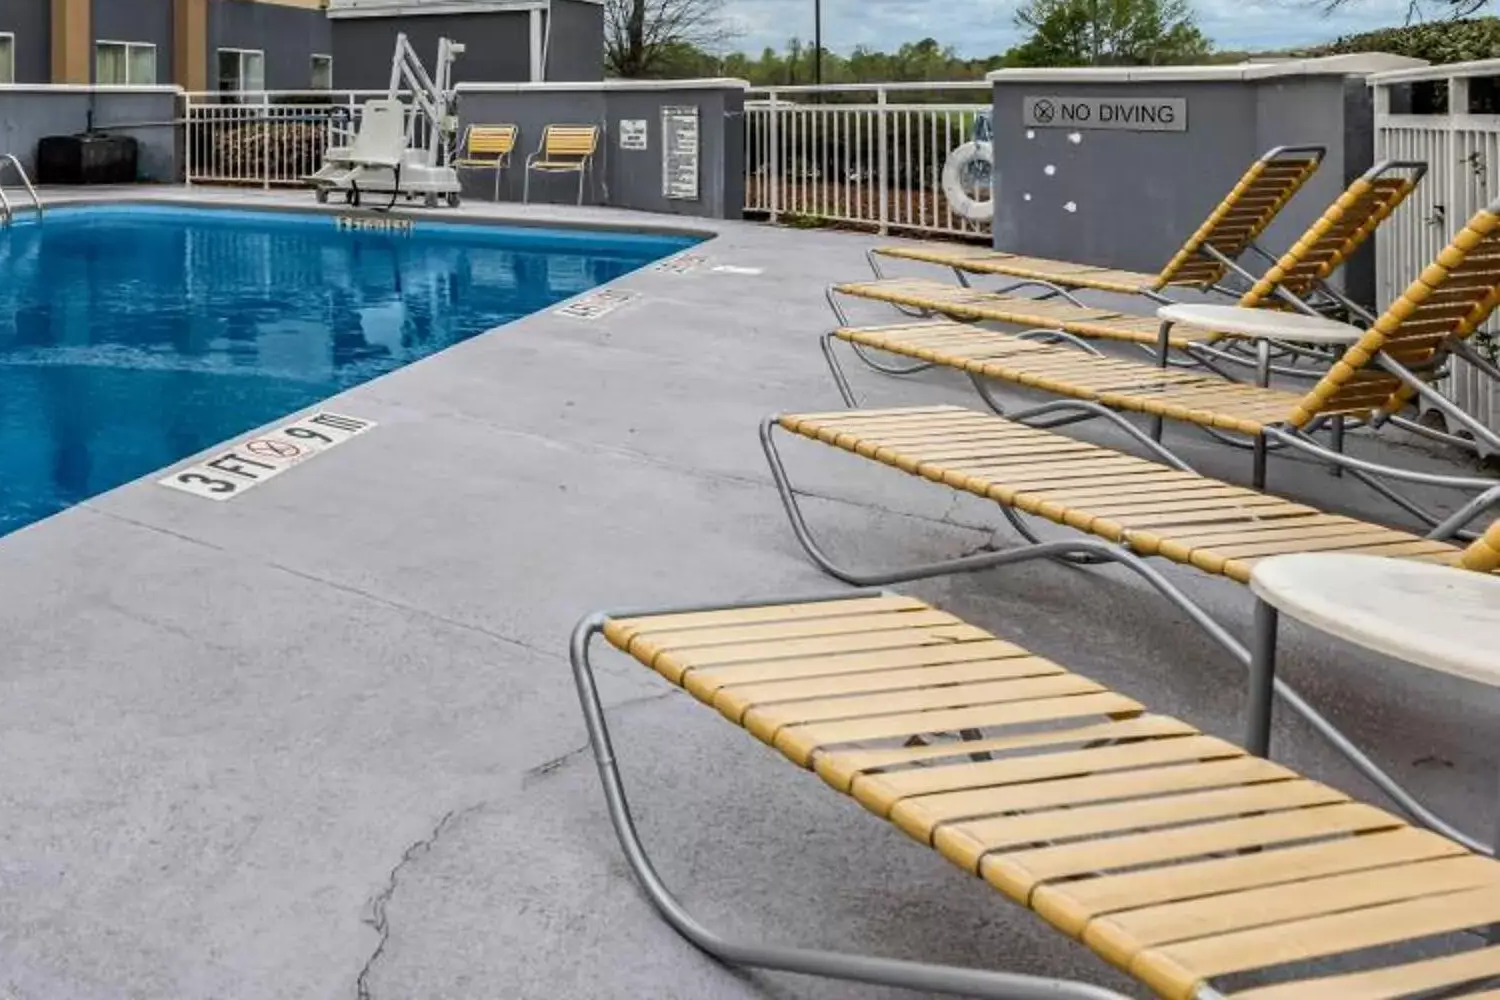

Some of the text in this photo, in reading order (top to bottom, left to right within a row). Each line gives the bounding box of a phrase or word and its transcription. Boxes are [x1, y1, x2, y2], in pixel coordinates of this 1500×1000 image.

[1061, 103, 1175, 123] NO DIVING
[284, 427, 333, 443] 9
[206, 453, 277, 479] FT
[177, 473, 237, 493] 3
